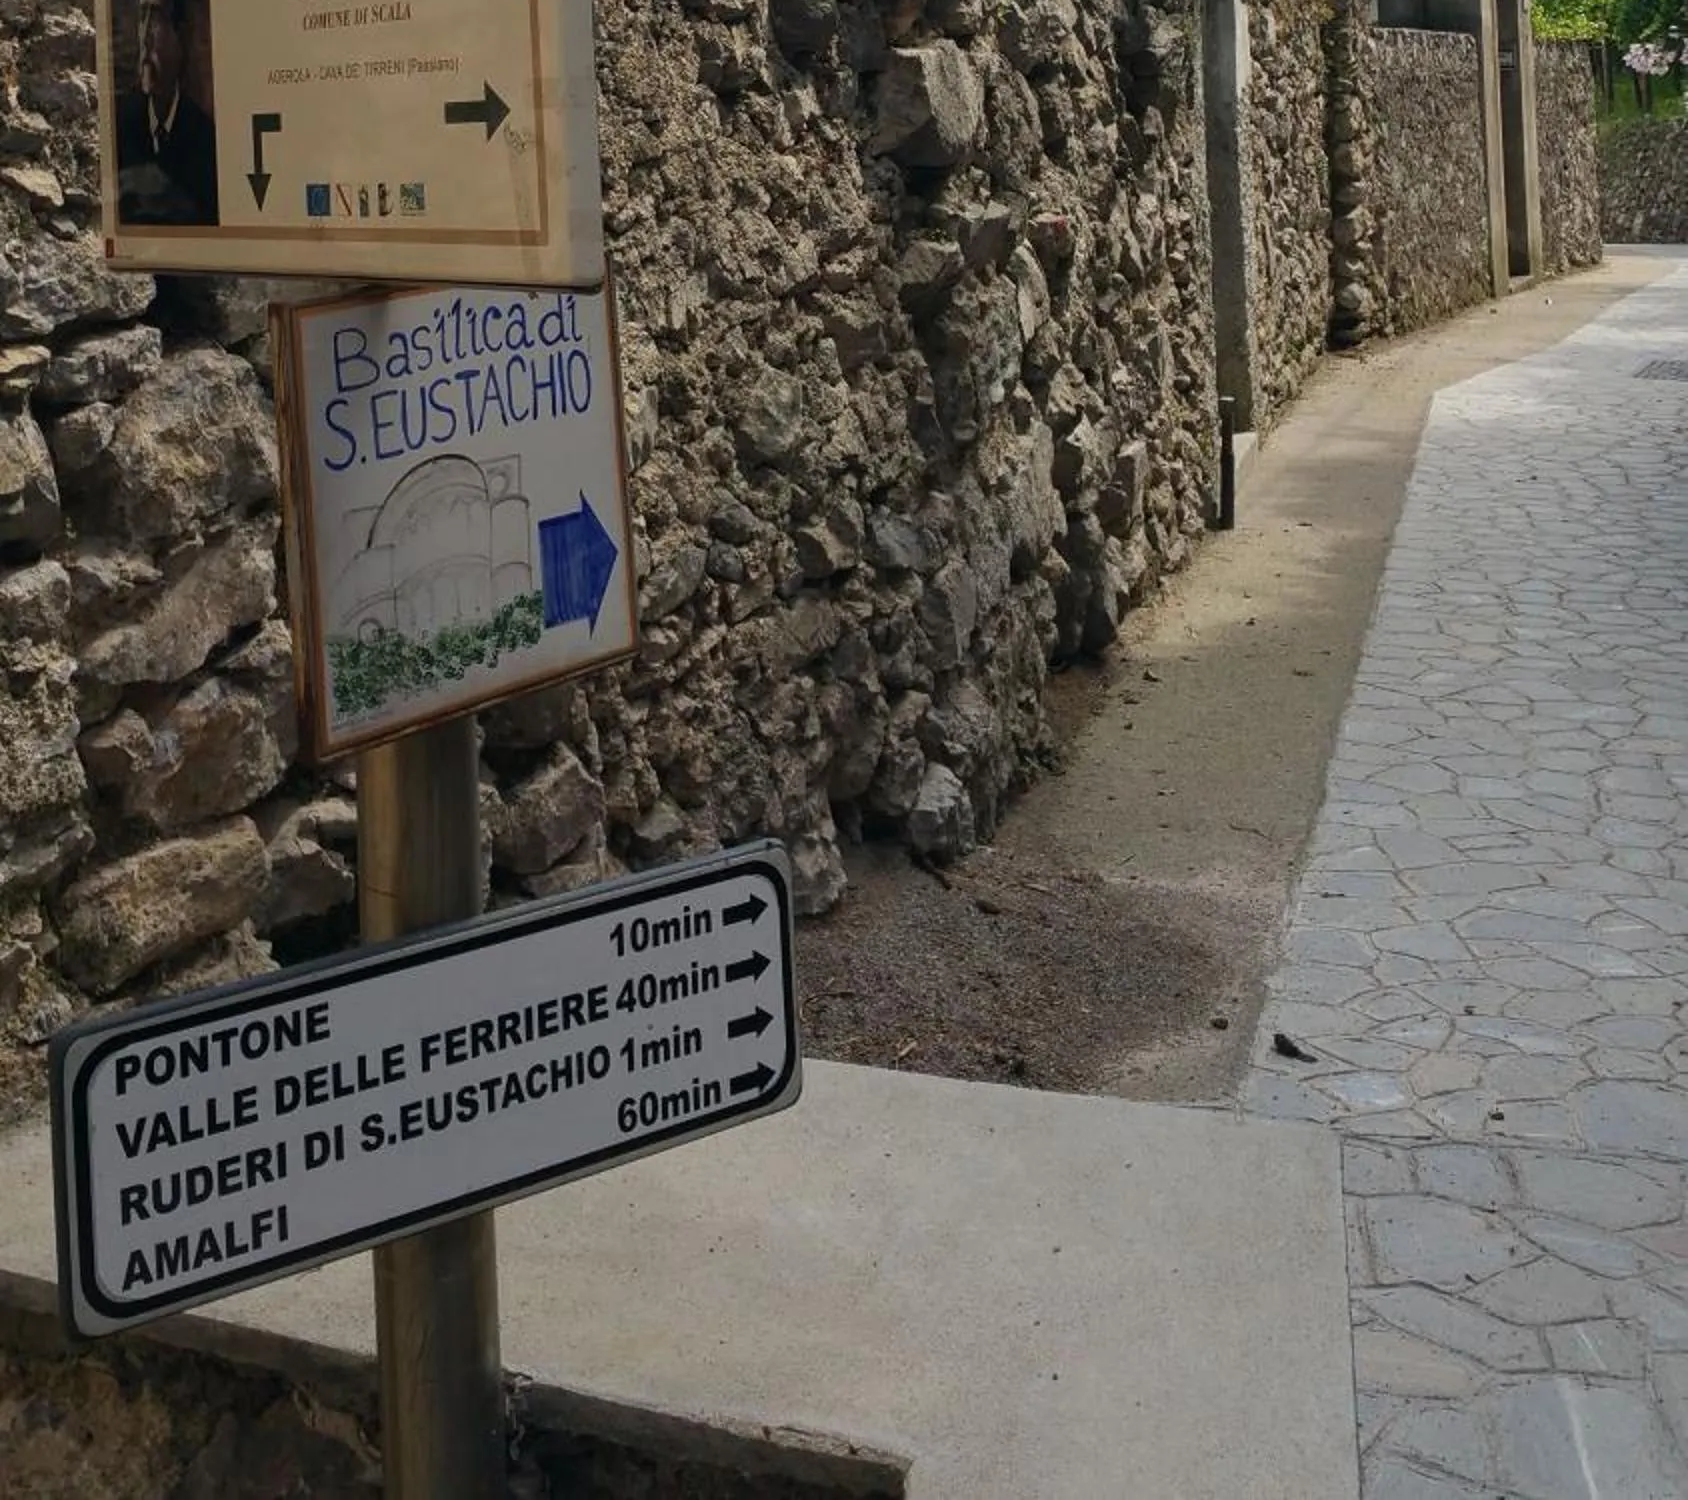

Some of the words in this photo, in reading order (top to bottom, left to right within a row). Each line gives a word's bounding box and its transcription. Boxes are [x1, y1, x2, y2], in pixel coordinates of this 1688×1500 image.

[303, 9, 350, 31] COMUNE
[371, 1, 411, 24] SCALA
[333, 297, 535, 394] Basilica
[538, 293, 584, 348] di
[115, 1003, 331, 1096] PONTONE
[608, 906, 713, 957] 10min
[116, 1090, 258, 1160] VALLE
[275, 1043, 406, 1111] DELLE
[421, 984, 610, 1073] FERRIERE
[616, 962, 720, 1012] 40min
[120, 1142, 288, 1226] RUDERI
[304, 1124, 344, 1172] DI
[360, 1044, 611, 1154] S.EUSTACHIO
[619, 1024, 702, 1074] 1min
[122, 1204, 290, 1293] AMALFI
[616, 1078, 722, 1134] 60min
